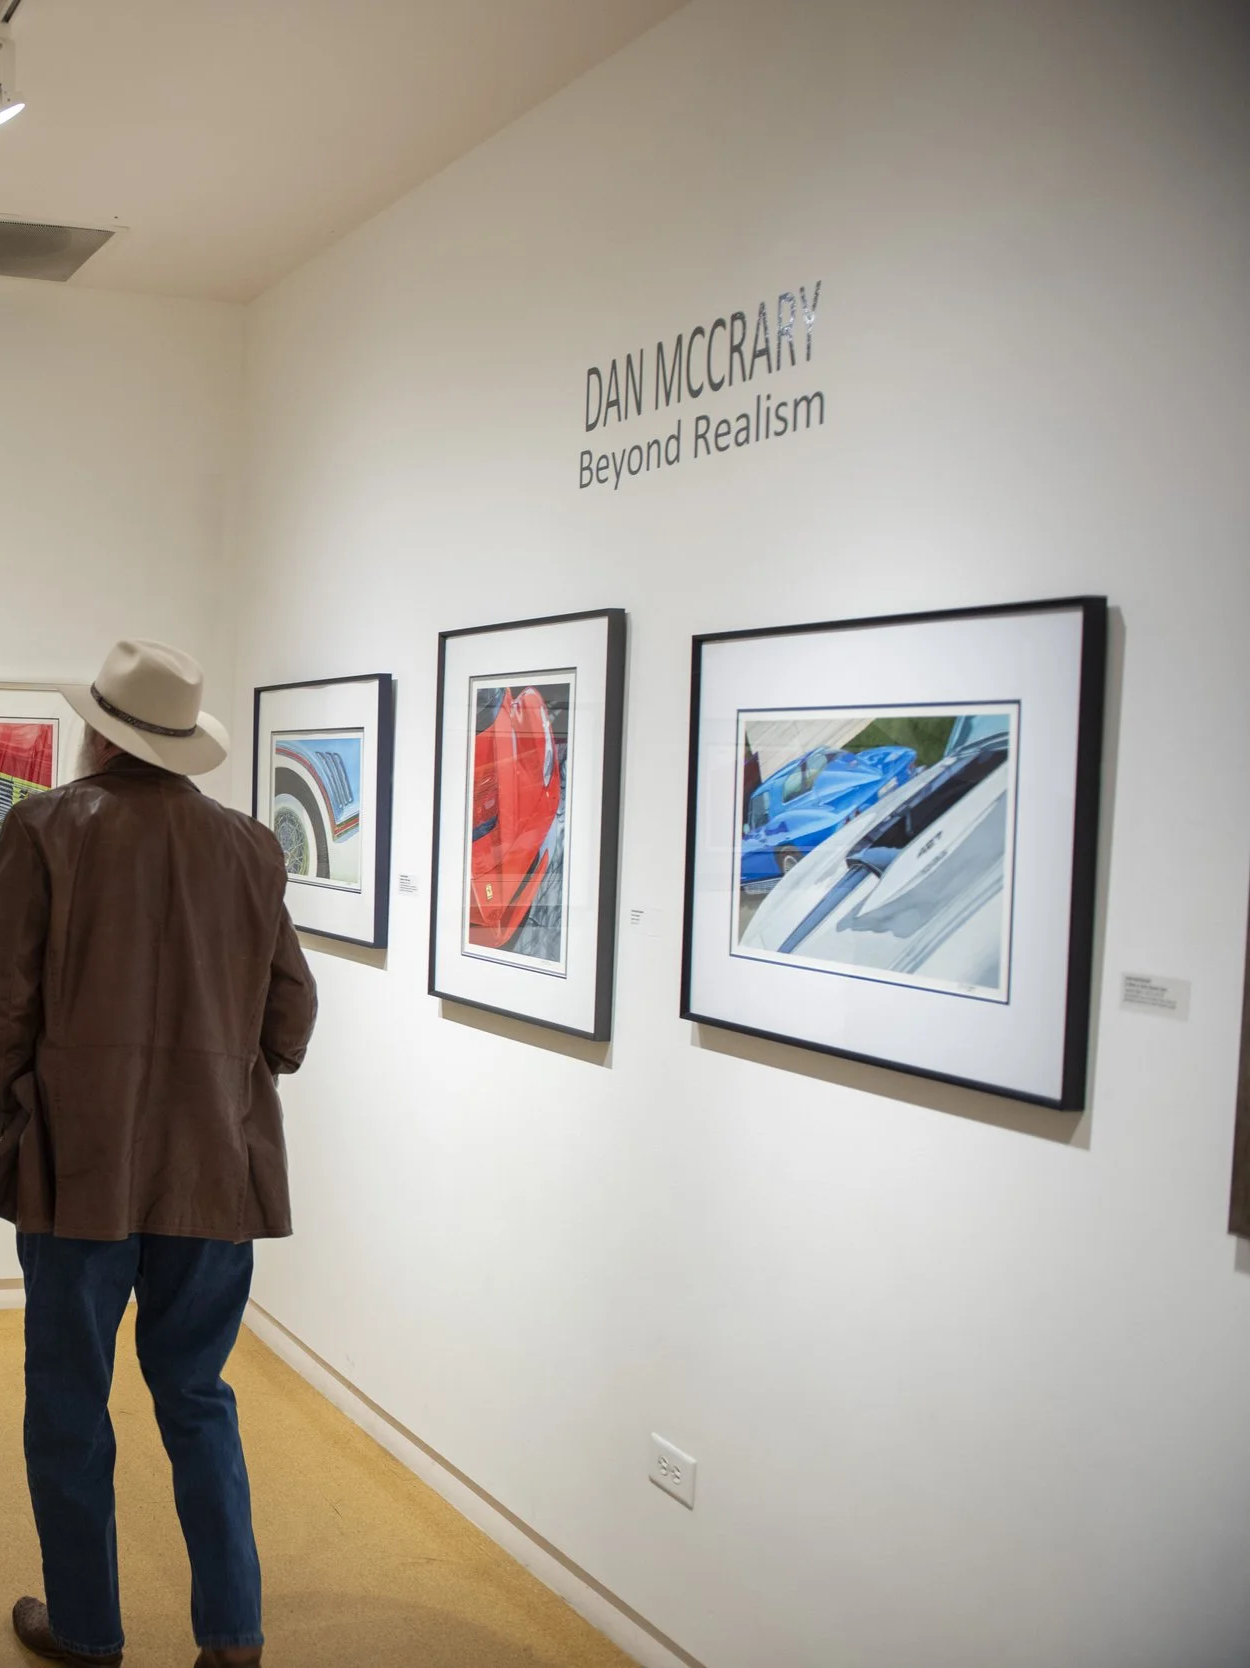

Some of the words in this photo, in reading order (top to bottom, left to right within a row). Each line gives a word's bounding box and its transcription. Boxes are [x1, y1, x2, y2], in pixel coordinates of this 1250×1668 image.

[585, 348, 644, 432] DAN
[654, 280, 822, 411] MCCRARY
[579, 419, 682, 490] Beyond
[693, 390, 826, 459] Realism
